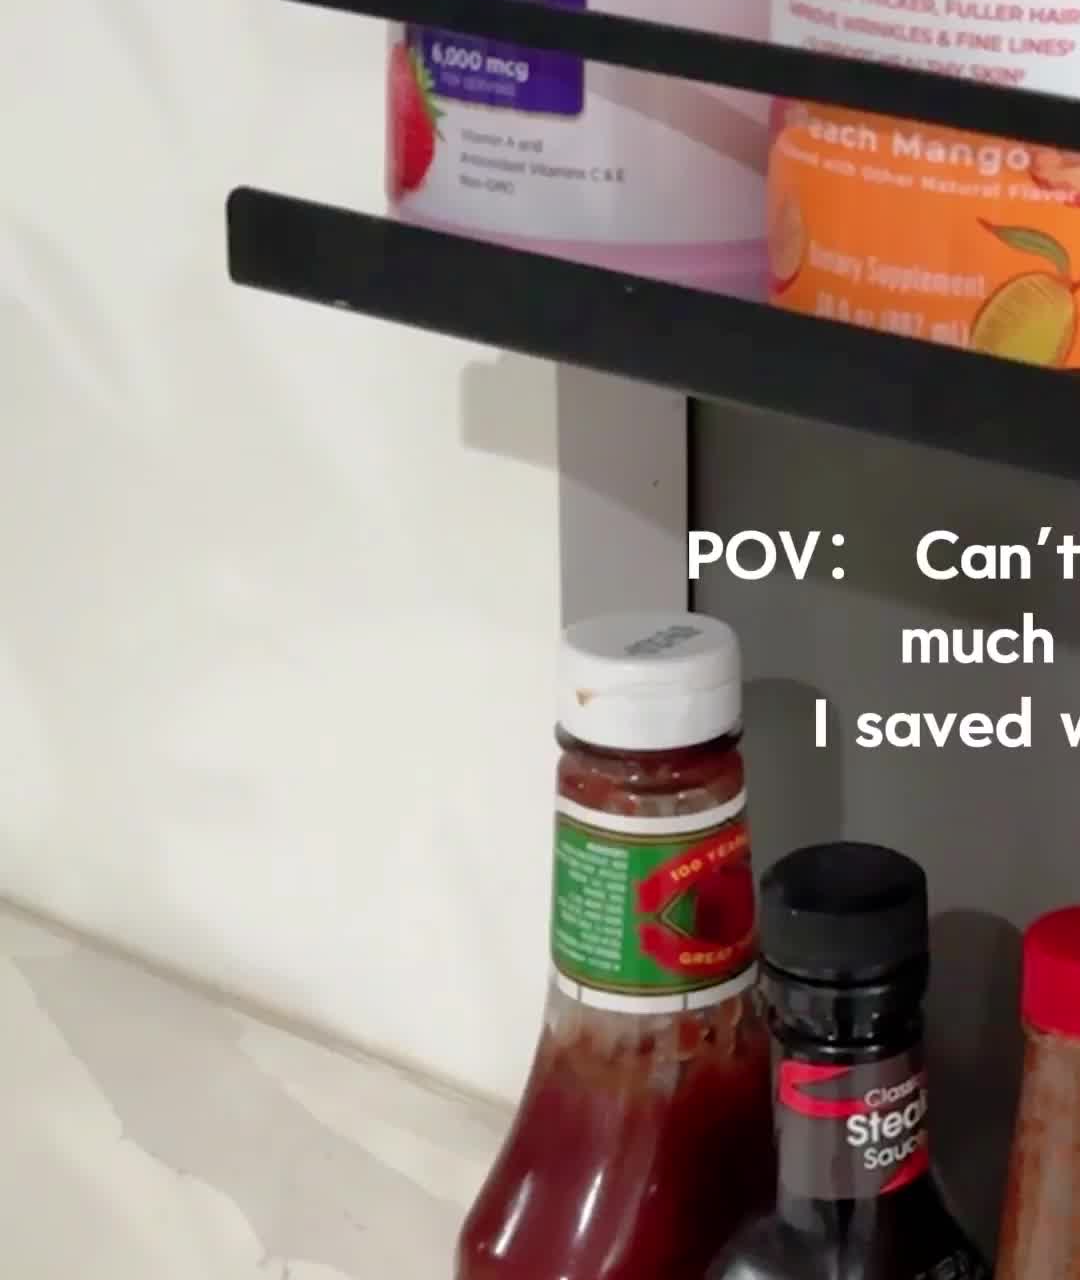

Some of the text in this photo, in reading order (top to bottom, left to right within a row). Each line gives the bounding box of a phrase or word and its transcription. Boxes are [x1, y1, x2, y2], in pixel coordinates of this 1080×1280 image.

[956, 30, 1001, 53] FINE
[485, 56, 530, 83] mcg
[891, 131, 1032, 176] Mango
[921, 175, 1000, 199] Natural
[669, 858, 703, 882] 100
